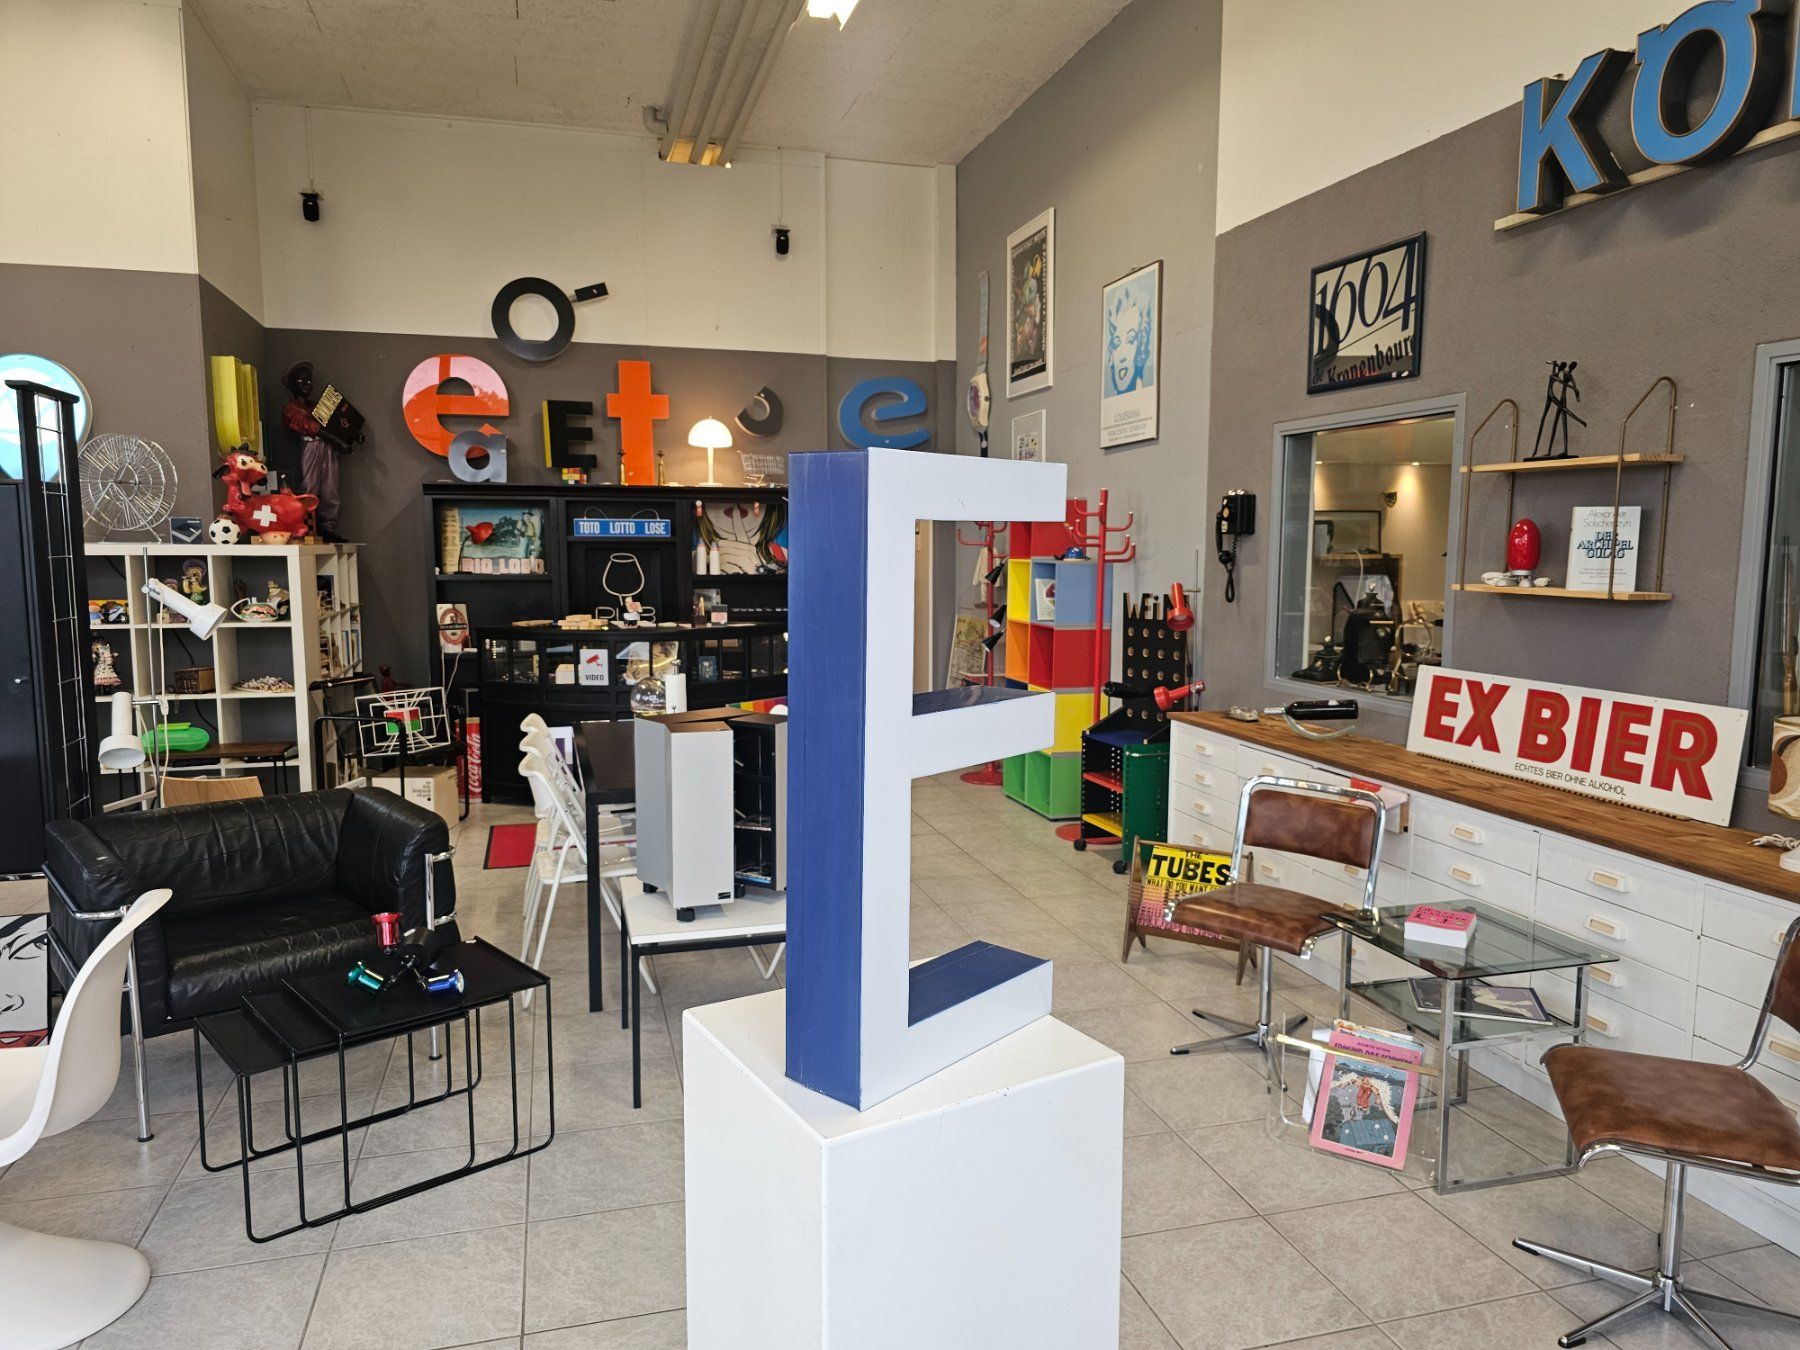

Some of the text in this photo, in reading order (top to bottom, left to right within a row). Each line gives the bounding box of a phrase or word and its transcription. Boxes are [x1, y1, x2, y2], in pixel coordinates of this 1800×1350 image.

[542, 400, 597, 468] E
[606, 360, 670, 485] t
[578, 521, 667, 534] TOTO LOTTO LOSE
[1423, 674, 1718, 801] EX BIER
[786, 449, 1067, 1110] E
[1514, 762, 1627, 796] ECHTES BIER OHNE ALKOHOL
[1152, 854, 1232, 886] TUBES
[1186, 851, 1202, 860] THE
[1146, 878, 1164, 888] WHAT
[1189, 883, 1208, 893] WANT
